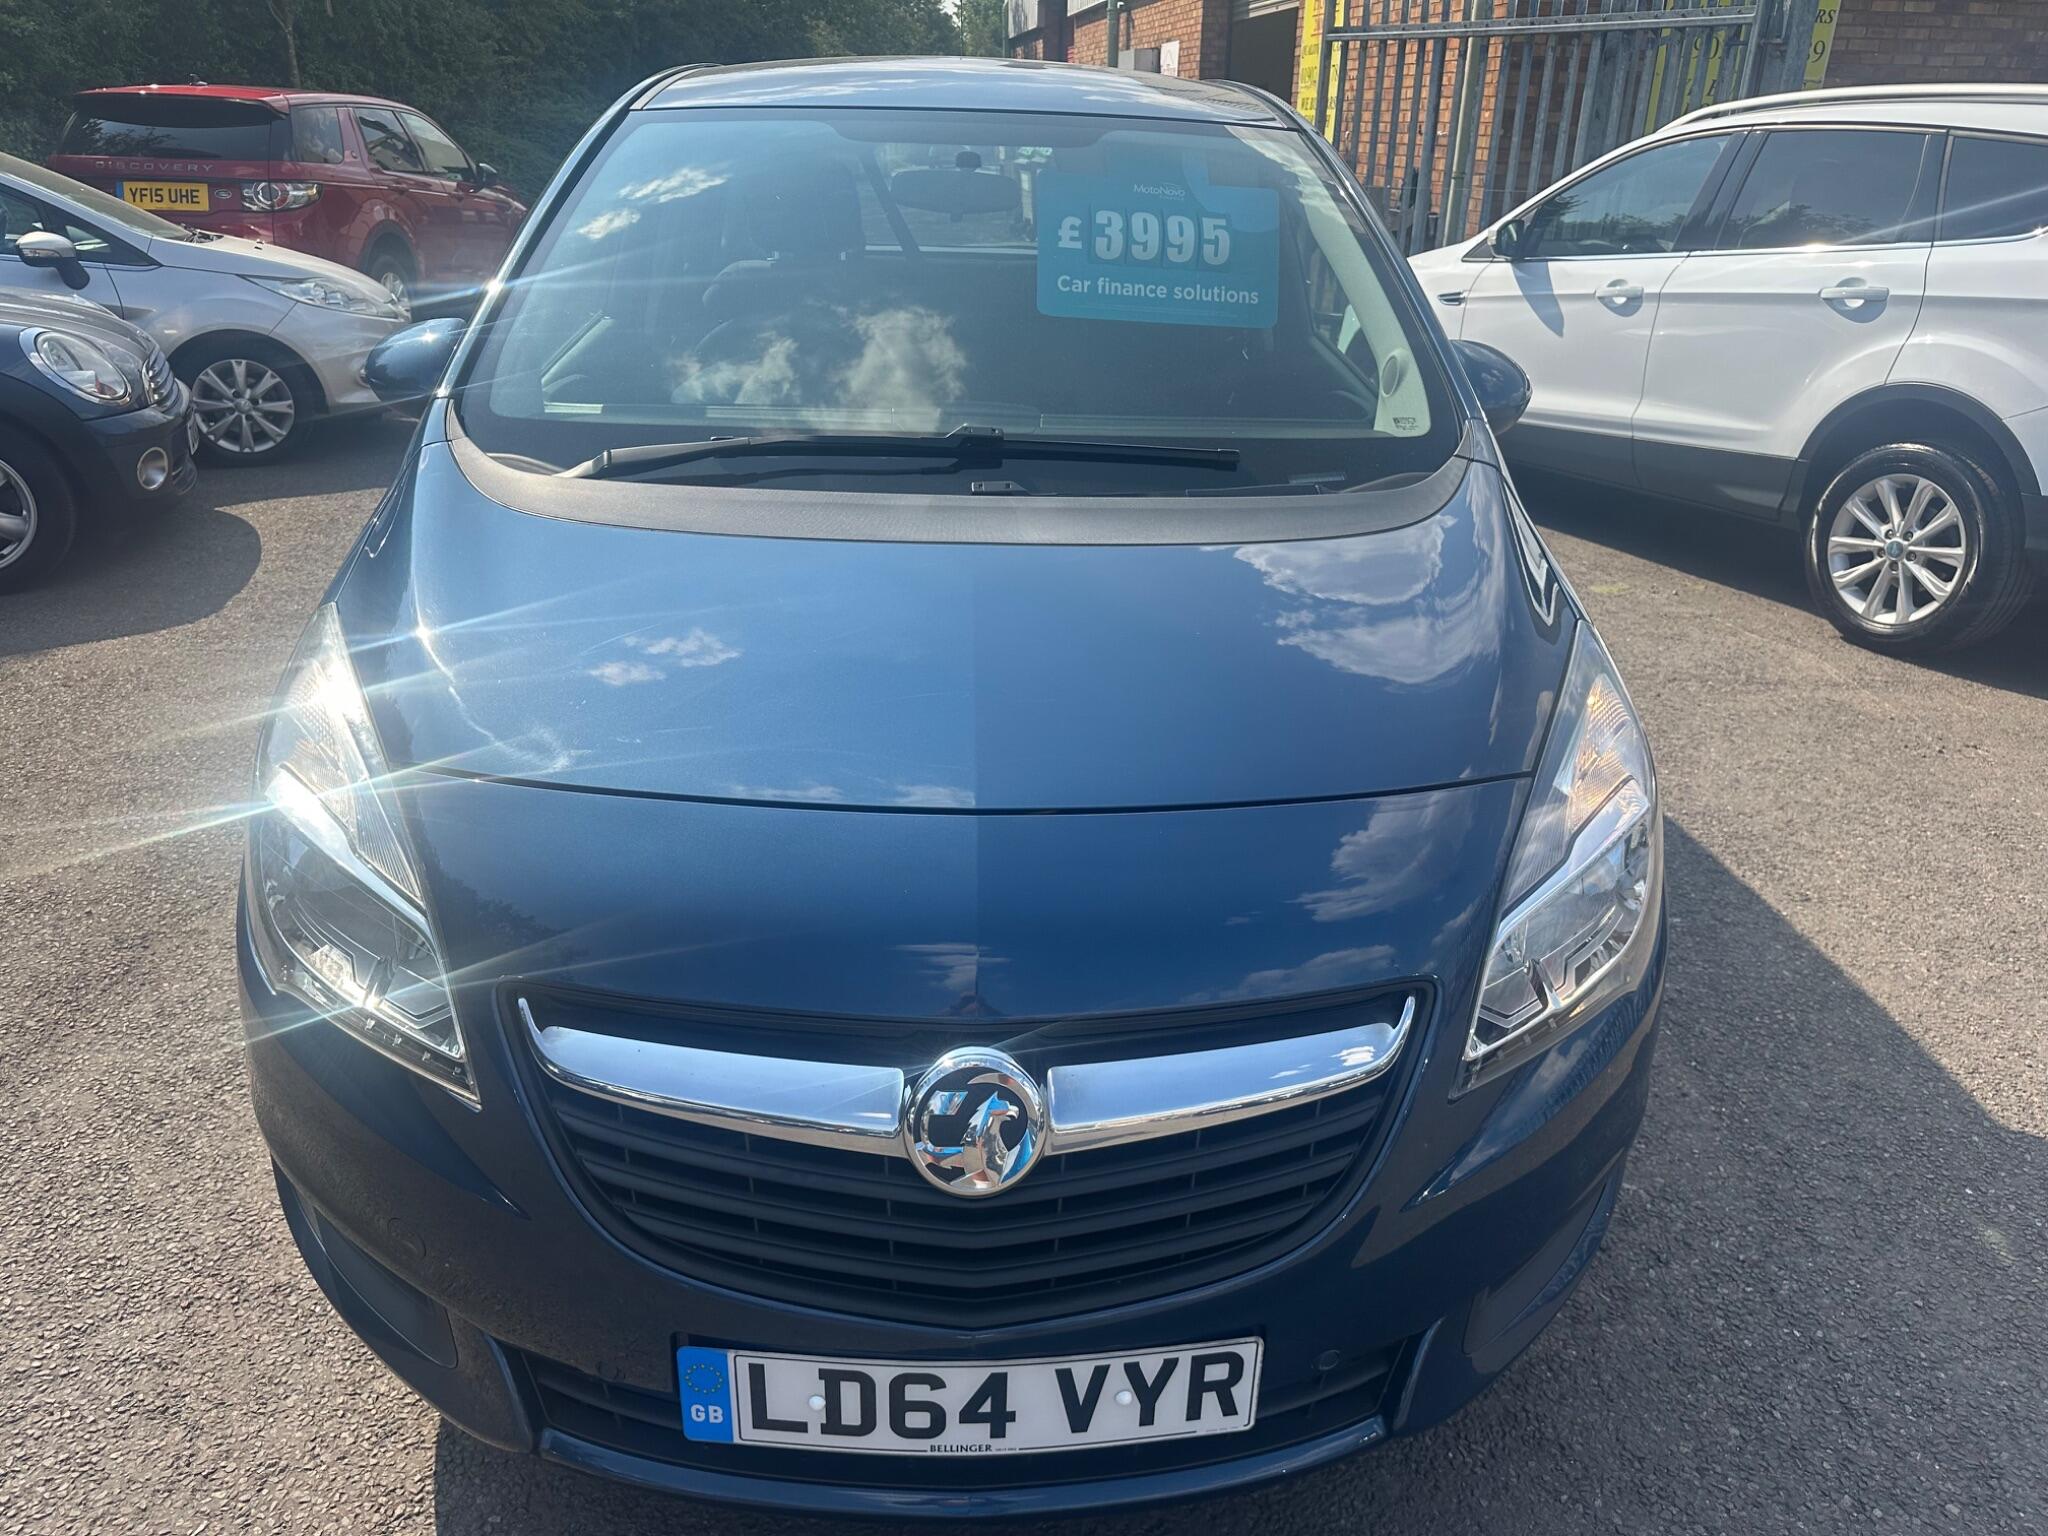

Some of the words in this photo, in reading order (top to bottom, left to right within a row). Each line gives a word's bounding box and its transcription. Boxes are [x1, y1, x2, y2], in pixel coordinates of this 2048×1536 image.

[95, 160, 214, 172] DISCOVERY
[129, 187, 164, 204] YF15
[168, 189, 200, 205] UHE
[1133, 183, 1185, 197] MotoNovo
[1057, 275, 1091, 294] Car
[1097, 277, 1168, 299] finance
[1173, 283, 1259, 305] solutions
[748, 1362, 1017, 1439] LD64
[1054, 1351, 1245, 1434] VYR
[690, 1404, 724, 1424] GB
[929, 1444, 993, 1454] BELLINGER
